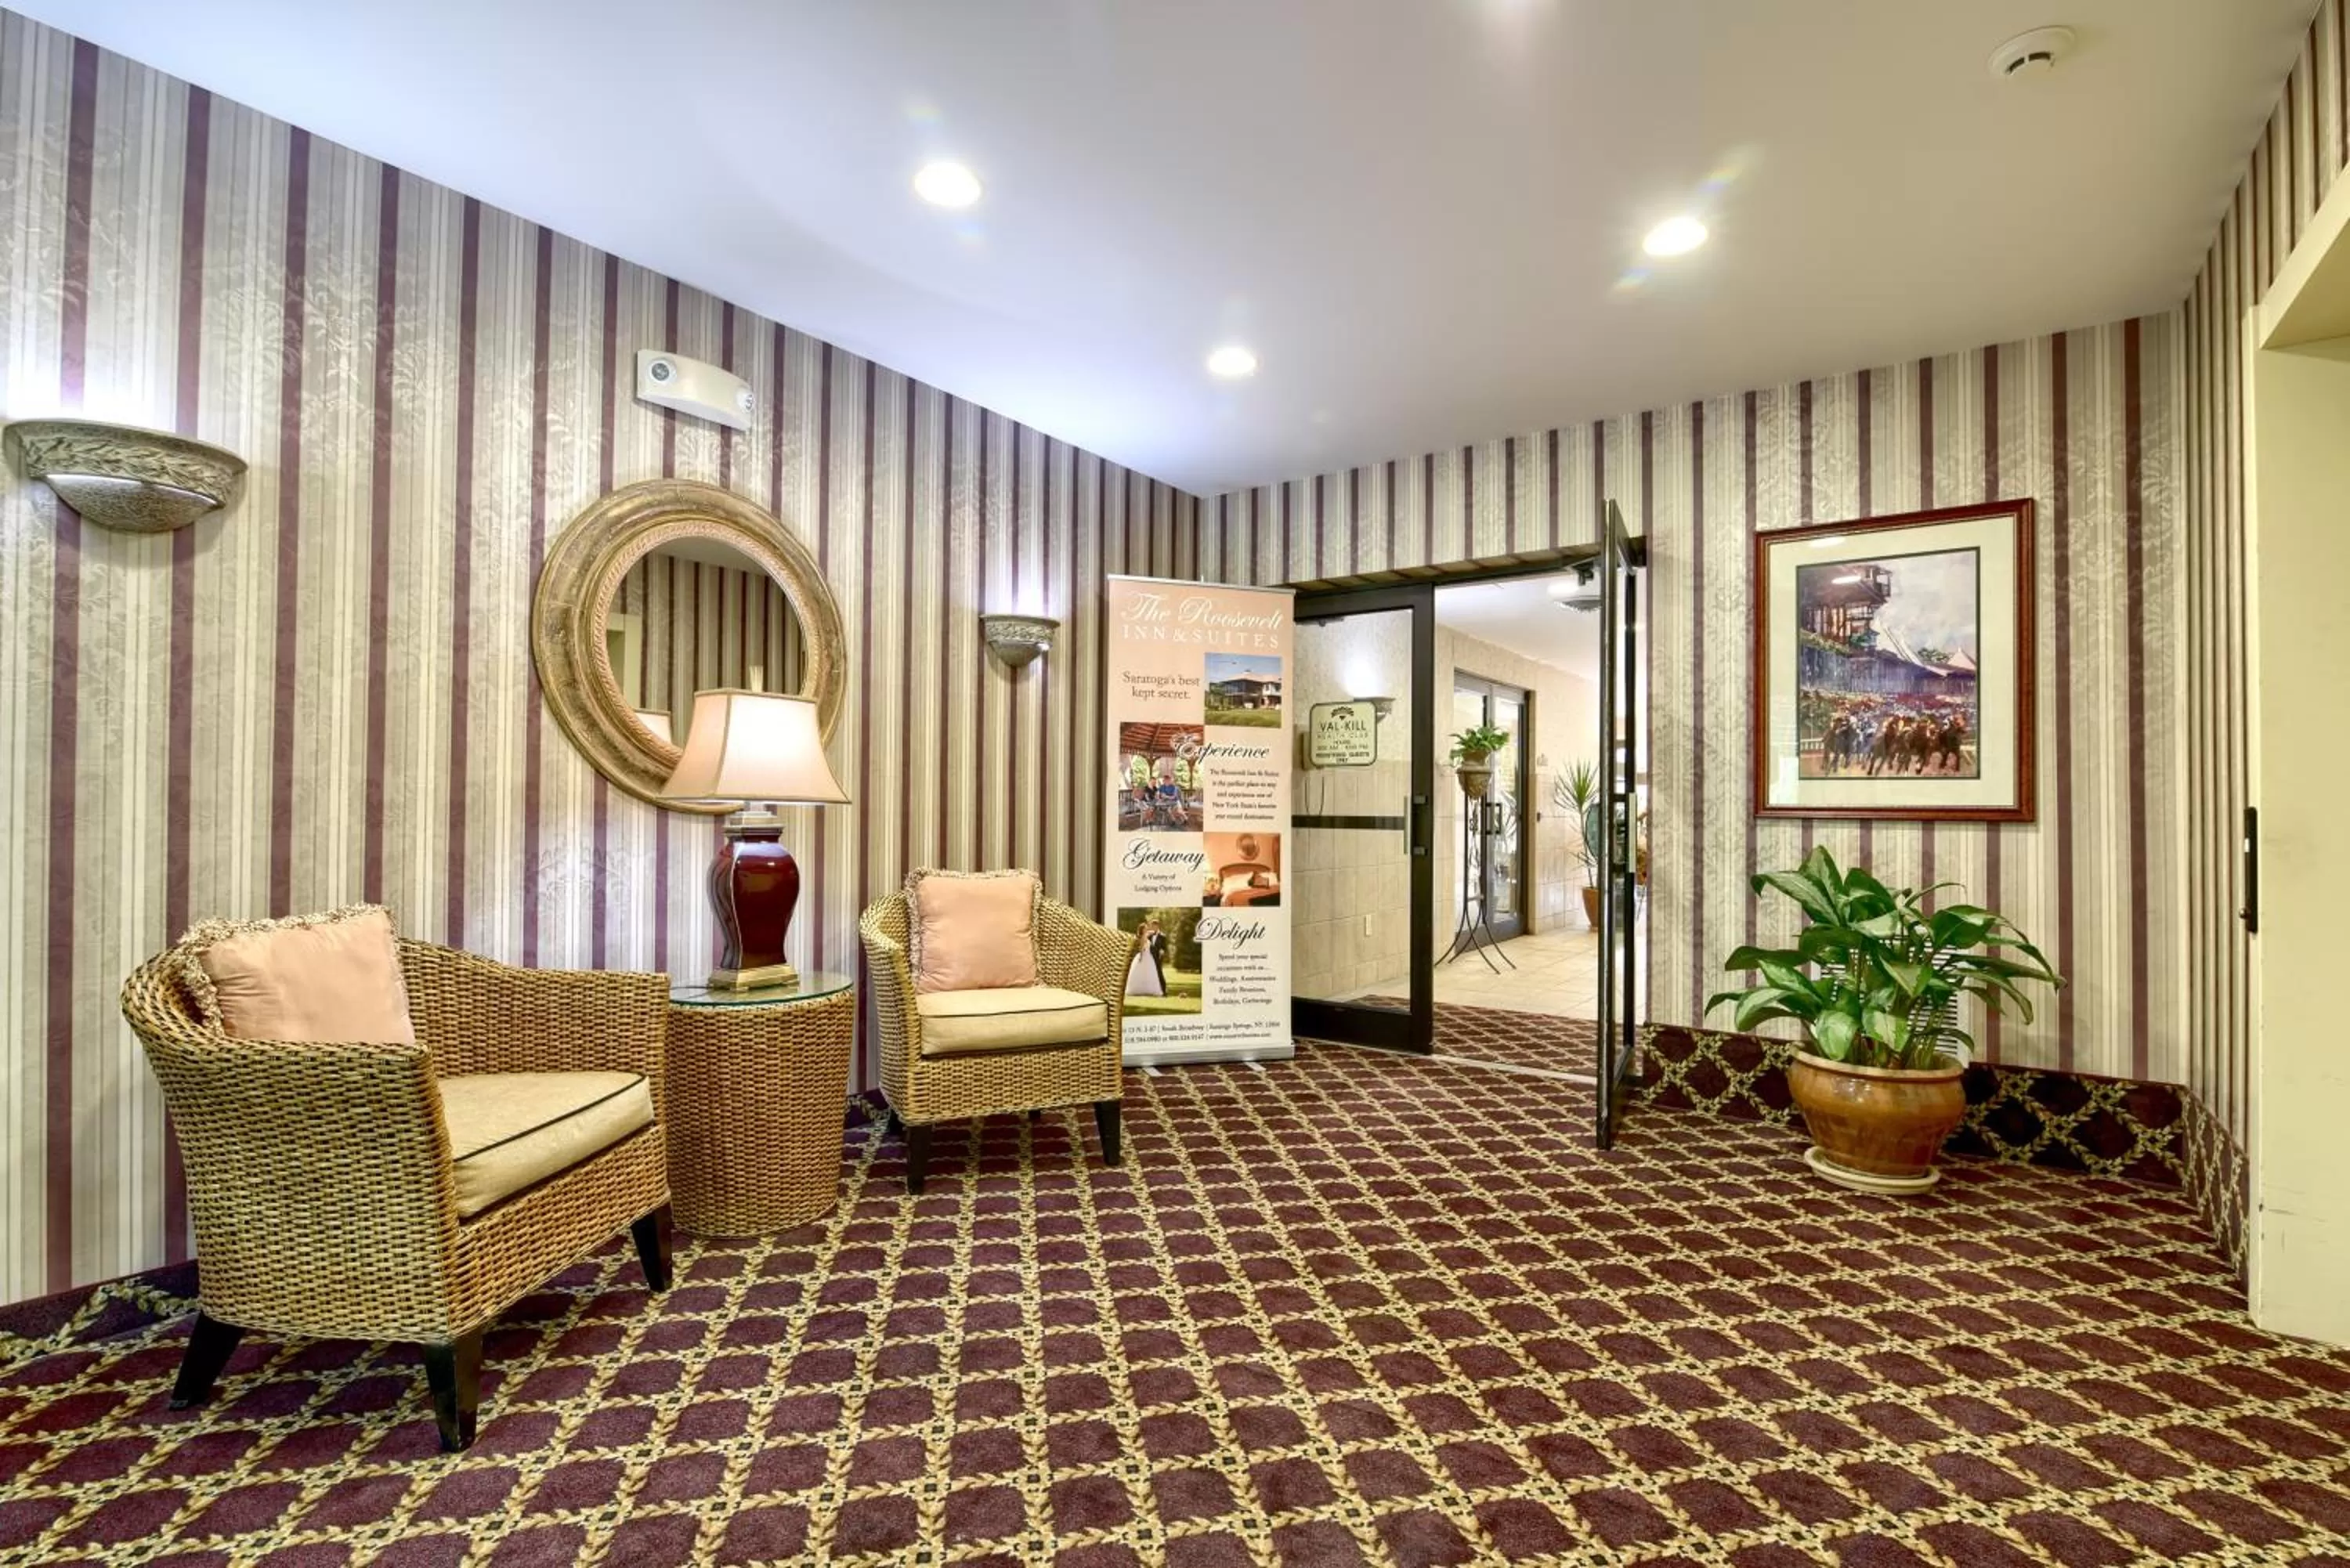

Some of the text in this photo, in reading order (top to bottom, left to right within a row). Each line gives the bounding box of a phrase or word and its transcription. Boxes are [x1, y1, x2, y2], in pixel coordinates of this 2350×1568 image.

[1121, 593, 1282, 630] The Roosevelt
[1122, 624, 1167, 641] INN
[1191, 629, 1279, 649] SUITES
[1122, 670, 1200, 688] Saratoga's best
[1132, 685, 1191, 701] kept secret.
[1171, 733, 1270, 764] Experience
[1123, 838, 1204, 873] Getaway
[1195, 916, 1267, 949] Delight
